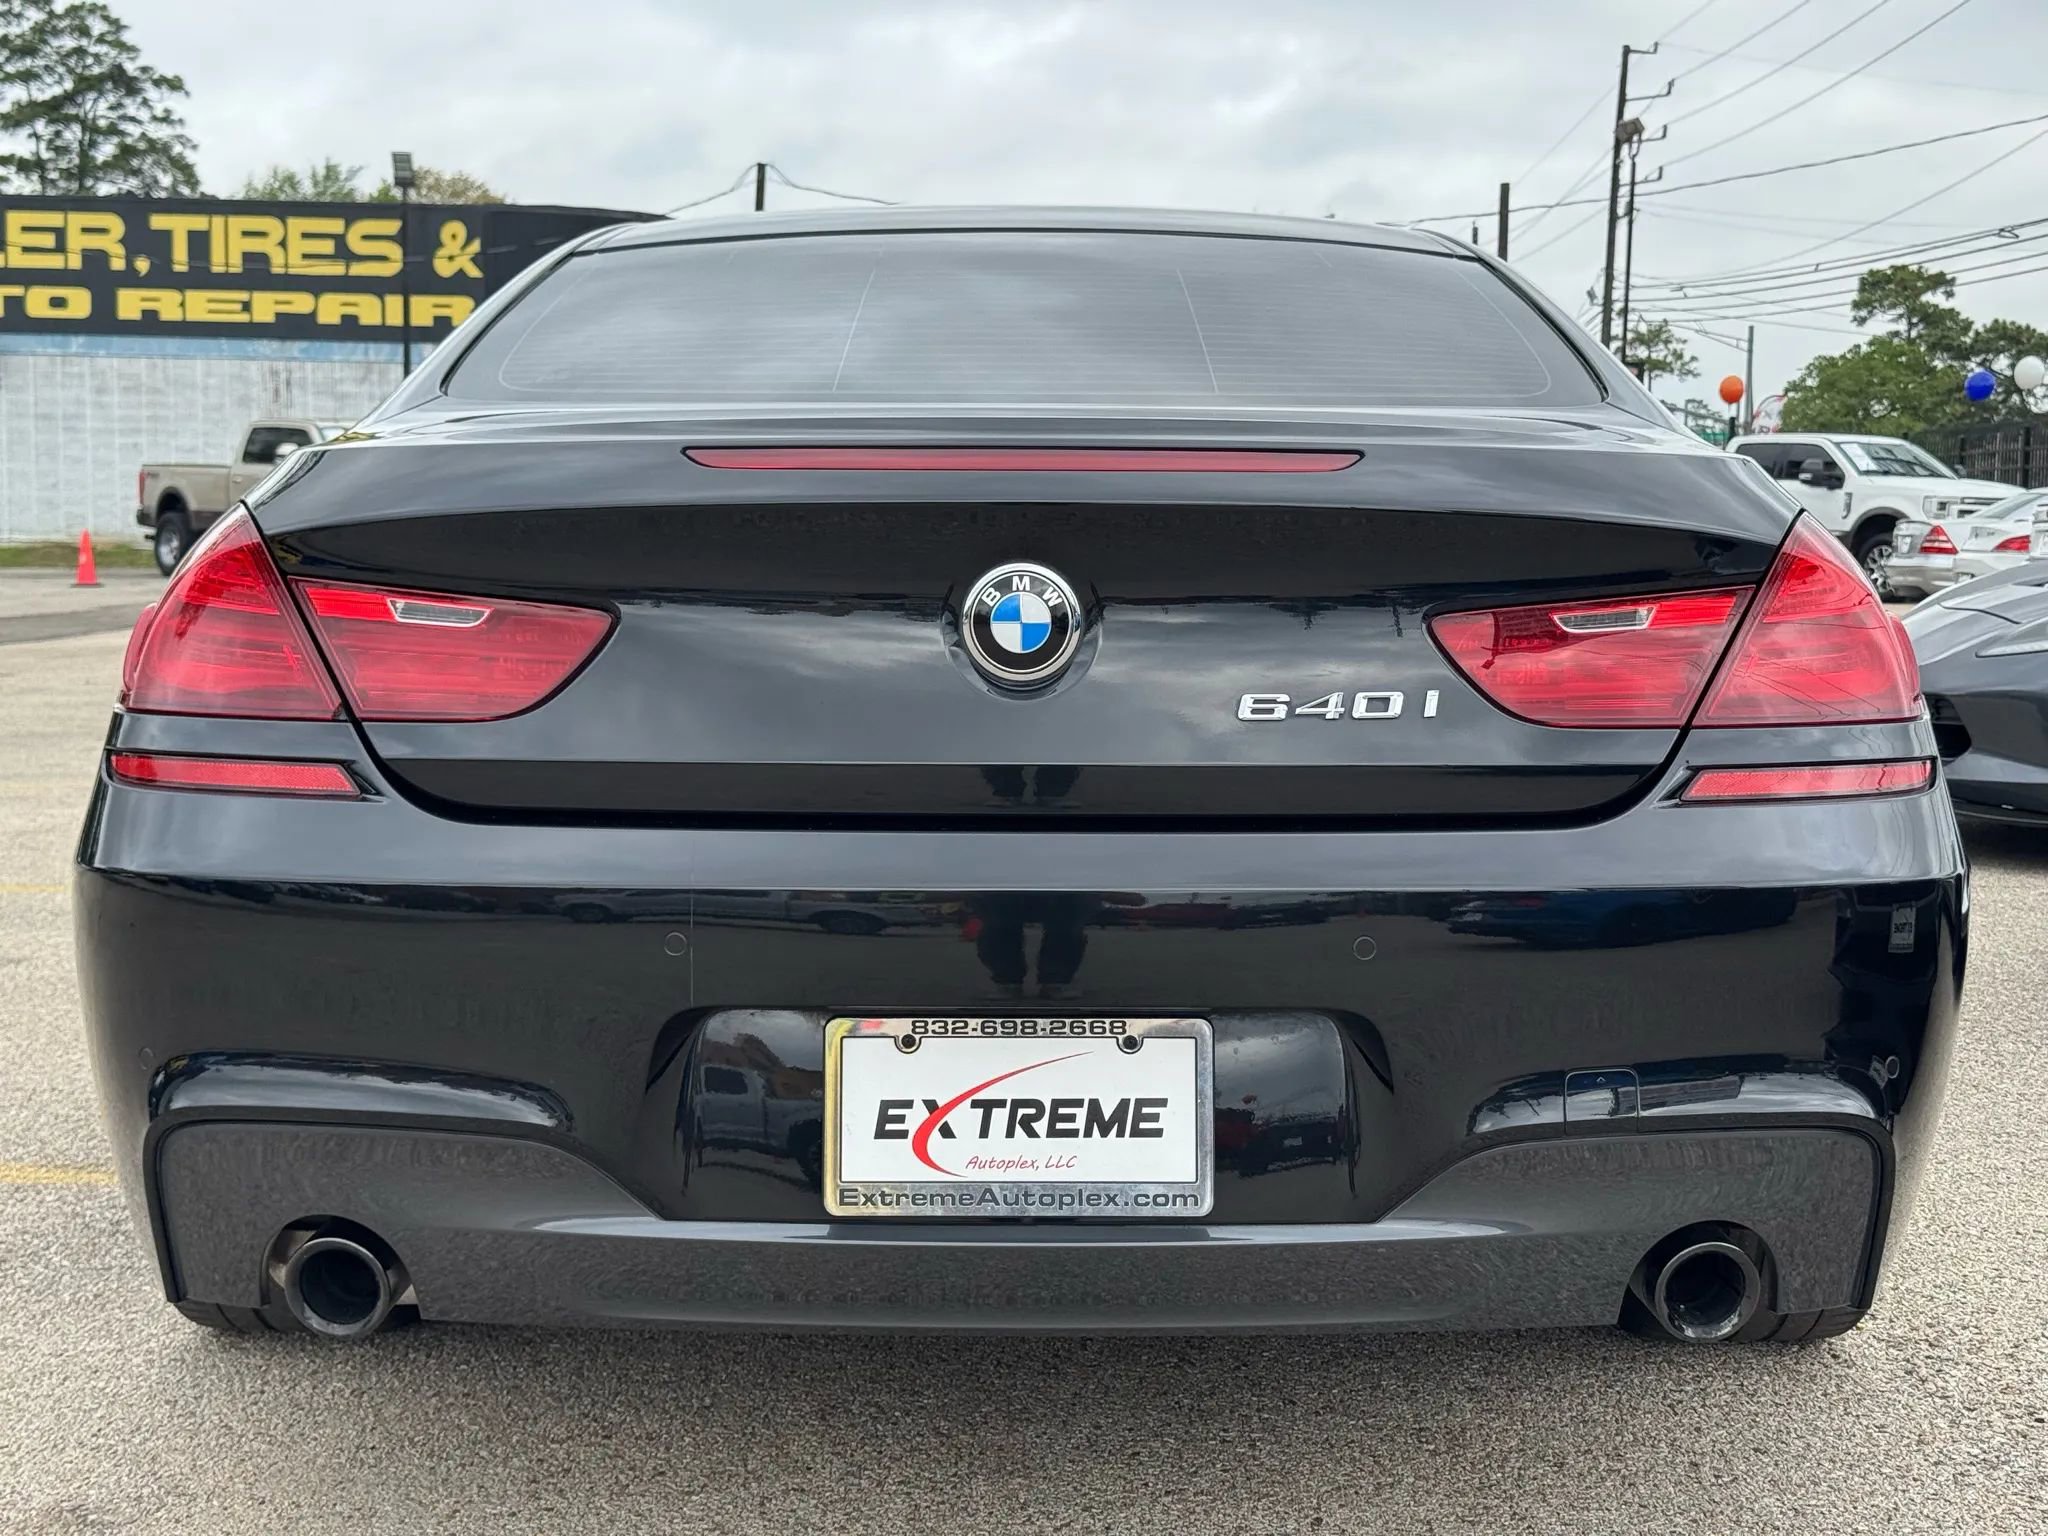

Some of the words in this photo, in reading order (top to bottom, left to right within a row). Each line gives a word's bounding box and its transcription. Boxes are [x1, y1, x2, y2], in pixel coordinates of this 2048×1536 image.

[433, 219, 484, 278] &
[117, 287, 476, 327] REPAIR
[981, 575, 1062, 607] BMW
[911, 1019, 1127, 1036] 832-698-2668
[873, 1097, 1169, 1140] EXTREME
[965, 1155, 1040, 1174] Autoplex,
[1044, 1155, 1078, 1169] LLC
[838, 1187, 1200, 1211] ExtremeAutoplex.com
